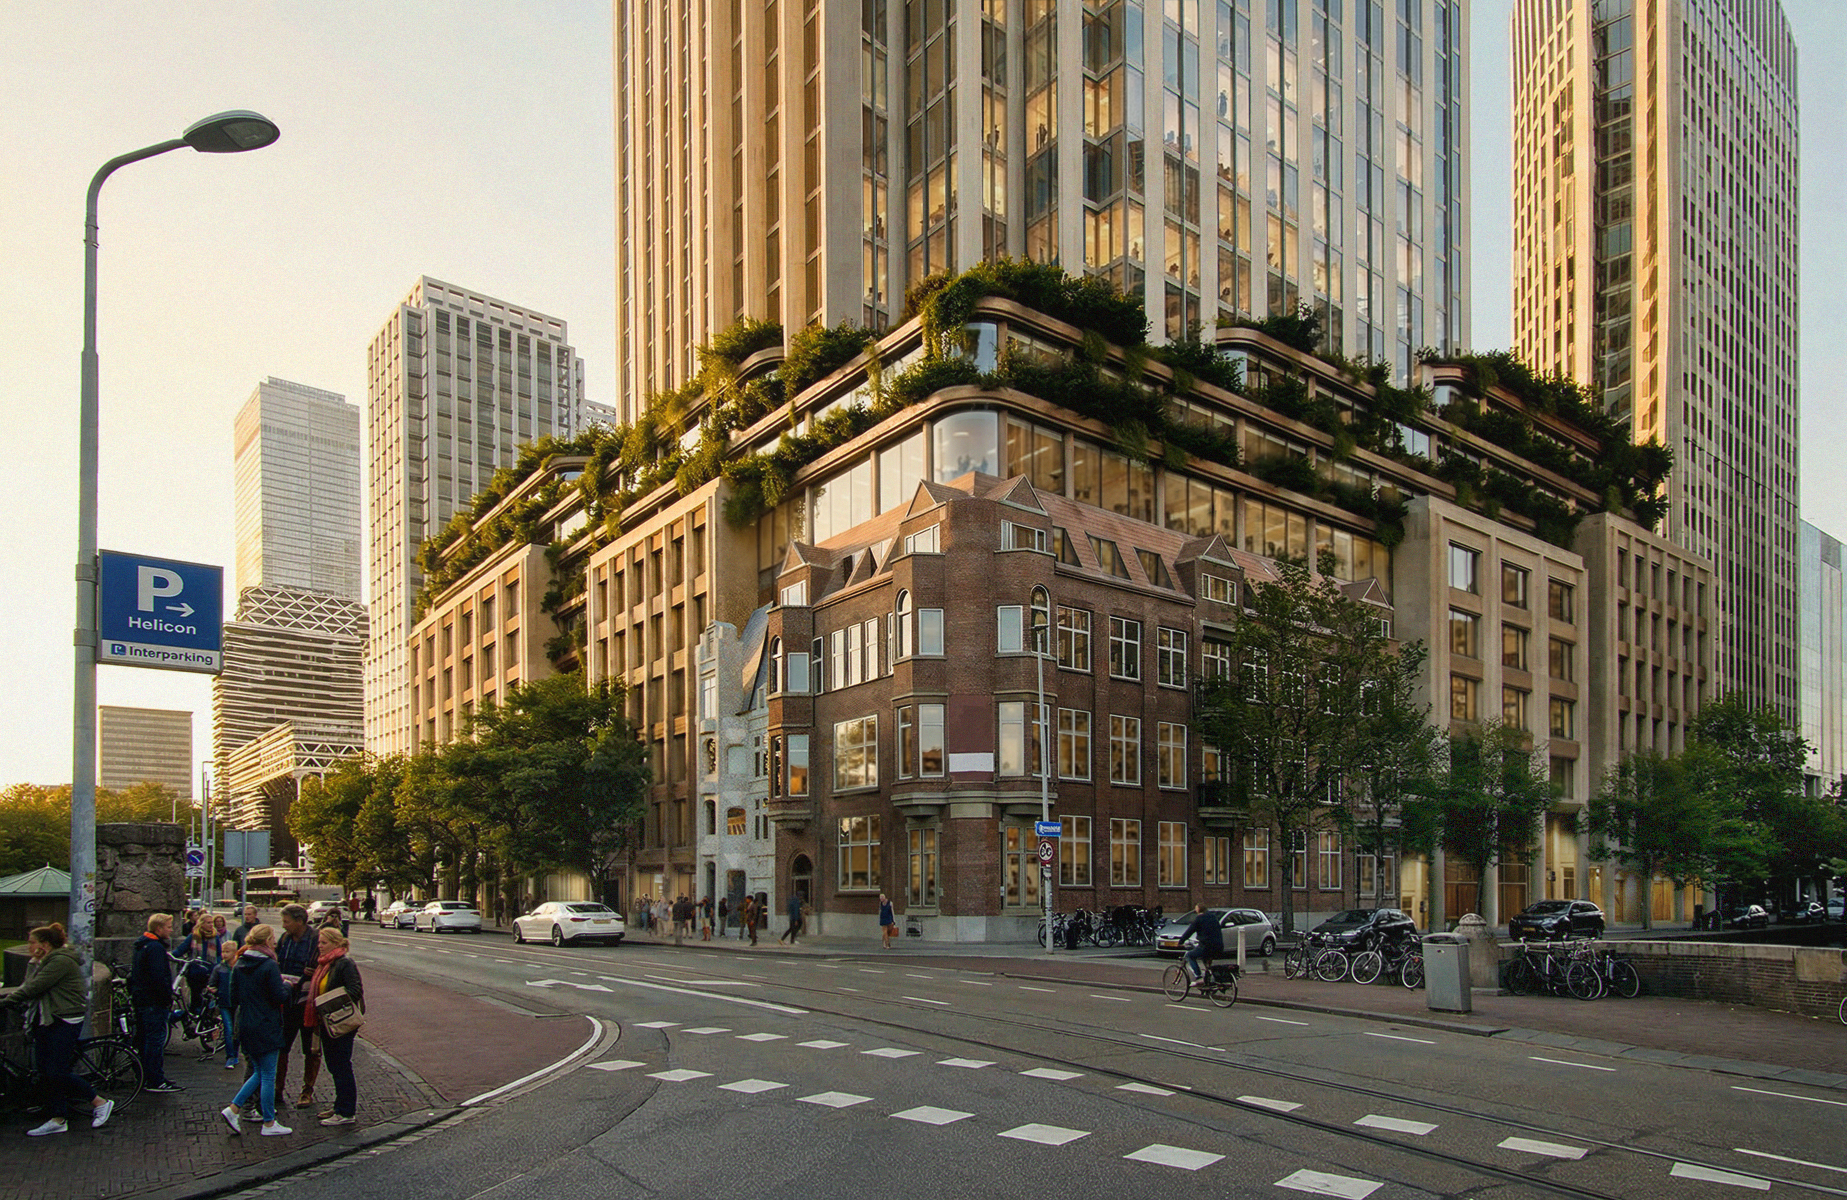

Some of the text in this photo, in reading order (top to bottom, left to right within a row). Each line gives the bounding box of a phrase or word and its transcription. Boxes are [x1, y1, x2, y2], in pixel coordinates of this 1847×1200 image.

[137, 565, 184, 612] P
[128, 616, 197, 635] Helicon
[129, 645, 213, 666] Interparking
